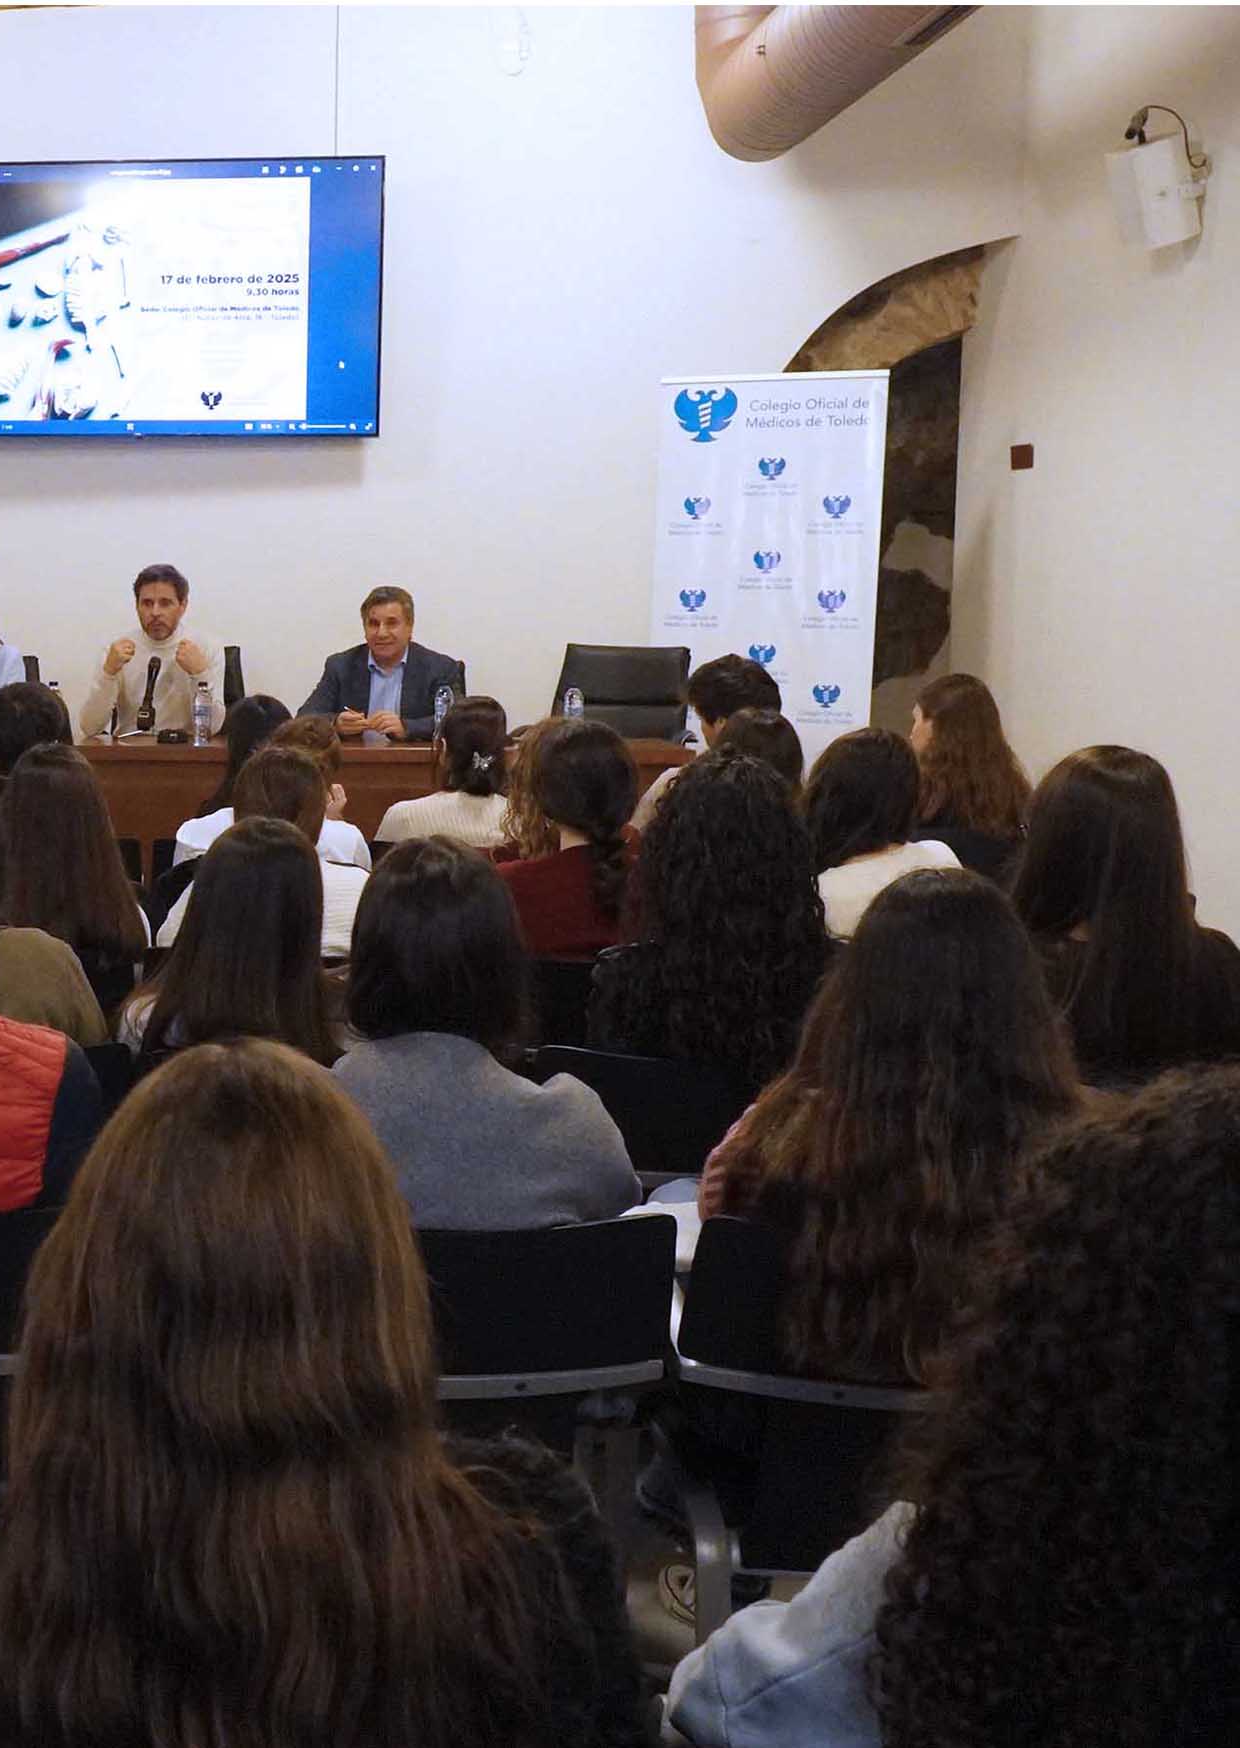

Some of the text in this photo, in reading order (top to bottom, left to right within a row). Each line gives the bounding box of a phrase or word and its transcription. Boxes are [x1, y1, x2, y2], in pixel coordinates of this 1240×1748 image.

[161, 273, 300, 285] 17 de febrero de 2025
[272, 287, 300, 296] horas
[750, 397, 869, 413] Colegio Oficial de
[746, 416, 800, 428] Médicos
[805, 415, 822, 427] de
